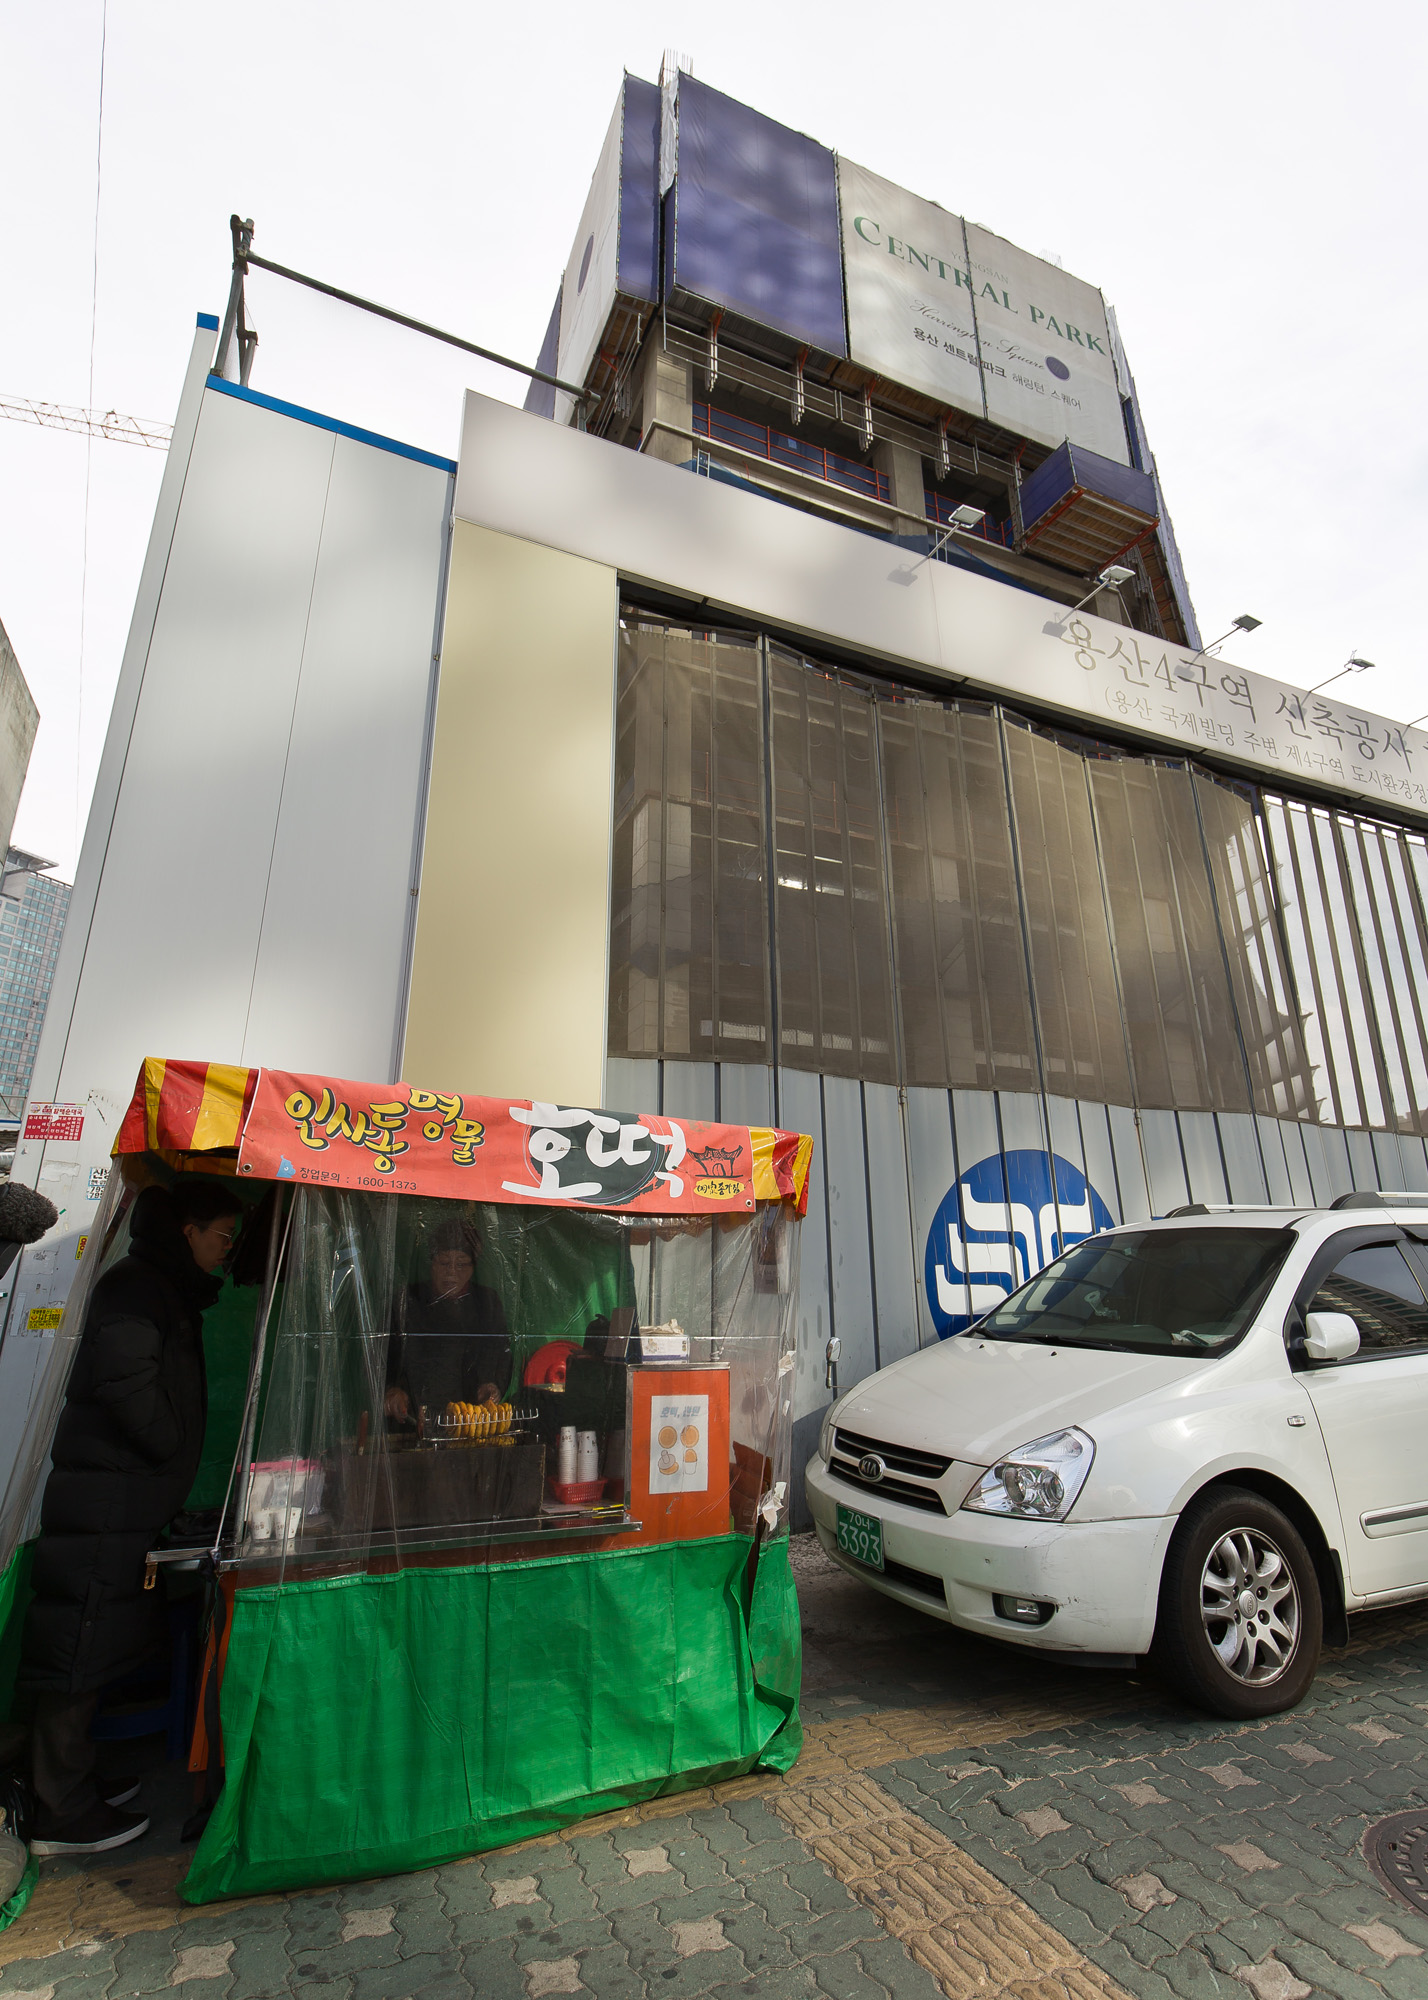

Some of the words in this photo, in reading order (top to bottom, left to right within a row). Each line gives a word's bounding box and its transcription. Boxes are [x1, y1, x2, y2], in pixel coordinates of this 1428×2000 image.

[853, 216, 1019, 314] CENTRAL
[1028, 304, 1107, 356] PARK
[909, 299, 993, 348] Harringtn
[997, 339, 1045, 371] Square
[913, 327, 939, 348] 용산
[943, 341, 1007, 378] 센트럴파크
[1012, 372, 1045, 395] 해링턴
[1051, 389, 1082, 411] 스퀘어
[1060, 618, 1257, 724] 용산4구역
[1275, 692, 1413, 773] 신축공사
[1104, 686, 1153, 722] (용산
[1160, 705, 1235, 747] 국제빌딩
[1243, 730, 1279, 760] 주변
[1285, 744, 1345, 780] 제4구역
[1351, 765, 1428, 805] 도시환경정
[284, 1087, 410, 1175] 인사동
[407, 1087, 485, 1168] 명물
[501, 1101, 687, 1199] 호떡
[299, 1167, 341, 1184] 창업문의
[356, 1175, 418, 1191] 1600-1373
[861, 1459, 878, 1477] KIA
[838, 1521, 881, 1565] 3393
[847, 1510, 870, 1531] 70너
